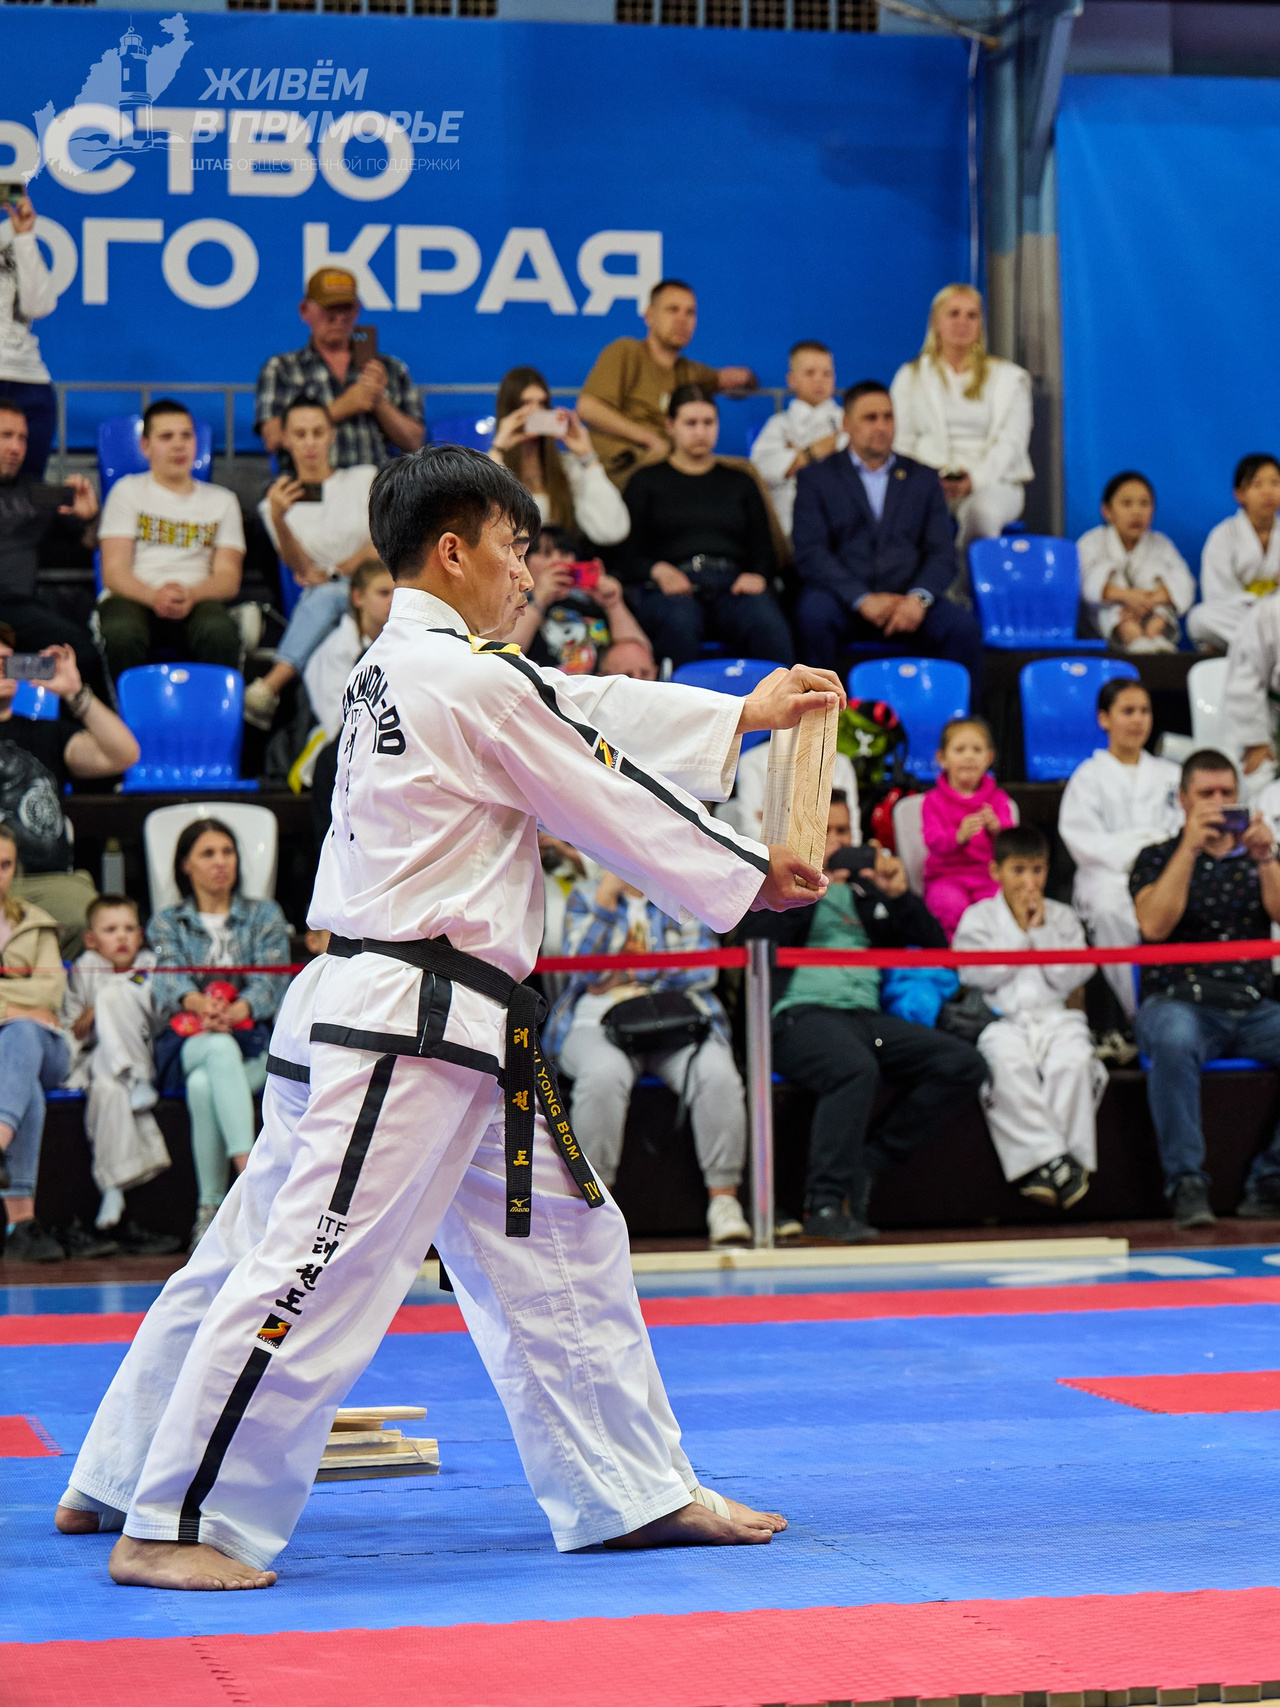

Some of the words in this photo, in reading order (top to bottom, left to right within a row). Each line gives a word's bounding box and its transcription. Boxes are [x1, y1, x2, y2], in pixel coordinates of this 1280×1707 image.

[303, 222, 663, 316] КРАЯ
[536, 1066, 562, 1118] YONG
[556, 1120, 580, 1161] BOM
[316, 1214, 348, 1237] ITF
